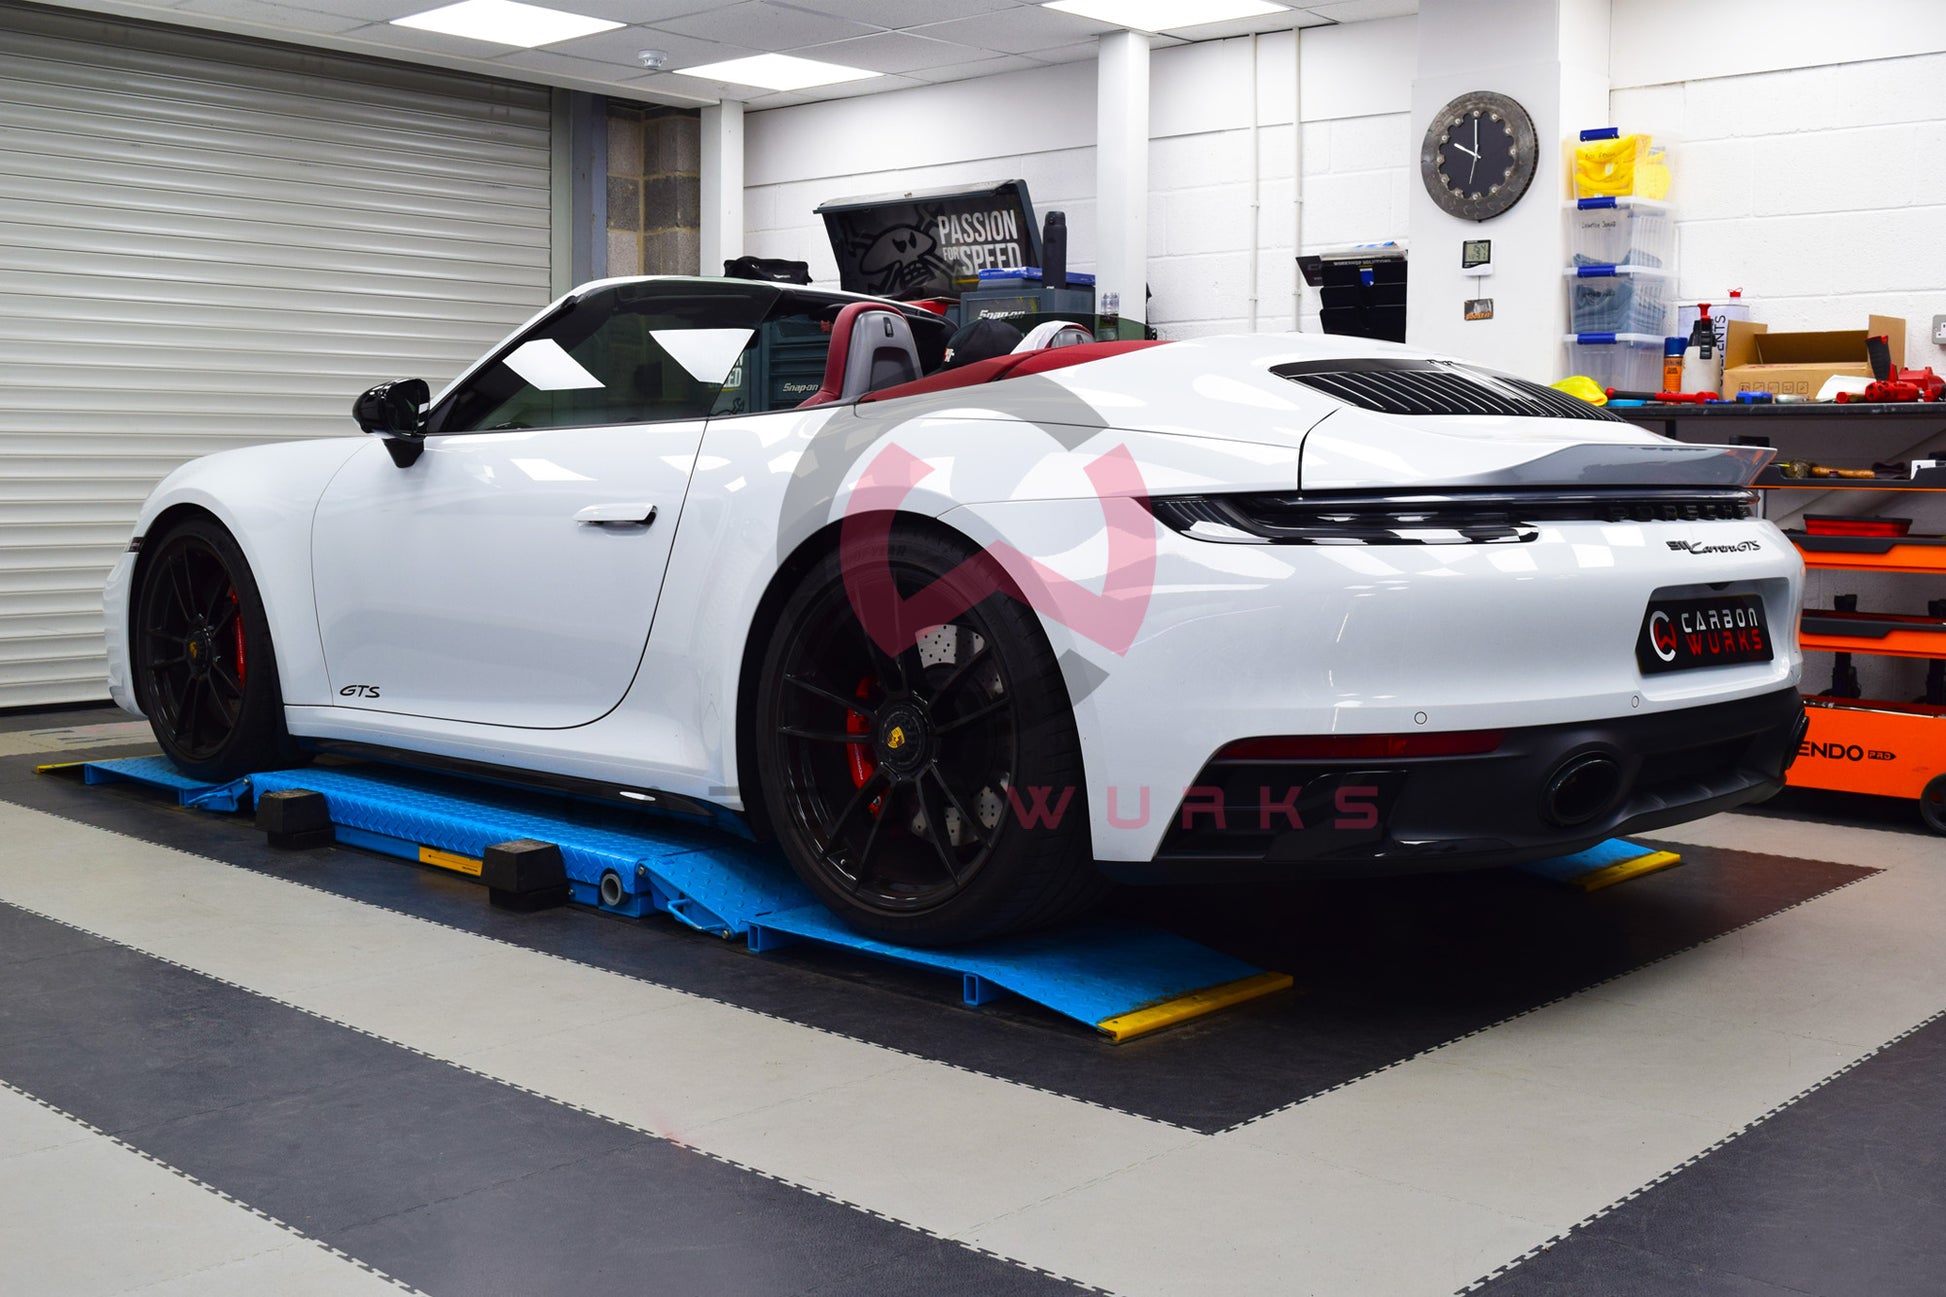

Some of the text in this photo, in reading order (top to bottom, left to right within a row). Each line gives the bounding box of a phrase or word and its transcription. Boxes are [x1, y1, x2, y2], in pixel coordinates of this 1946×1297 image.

[937, 209, 1018, 245] PASSION
[943, 246, 960, 261] FOR
[959, 242, 1022, 276] SPEED
[782, 382, 820, 394] Snap-on
[1736, 540, 1762, 552] GTS
[1681, 607, 1758, 633] CARBON
[1685, 628, 1763, 656] WURKS
[339, 684, 381, 699] GTS
[1868, 751, 1892, 760] PRO
